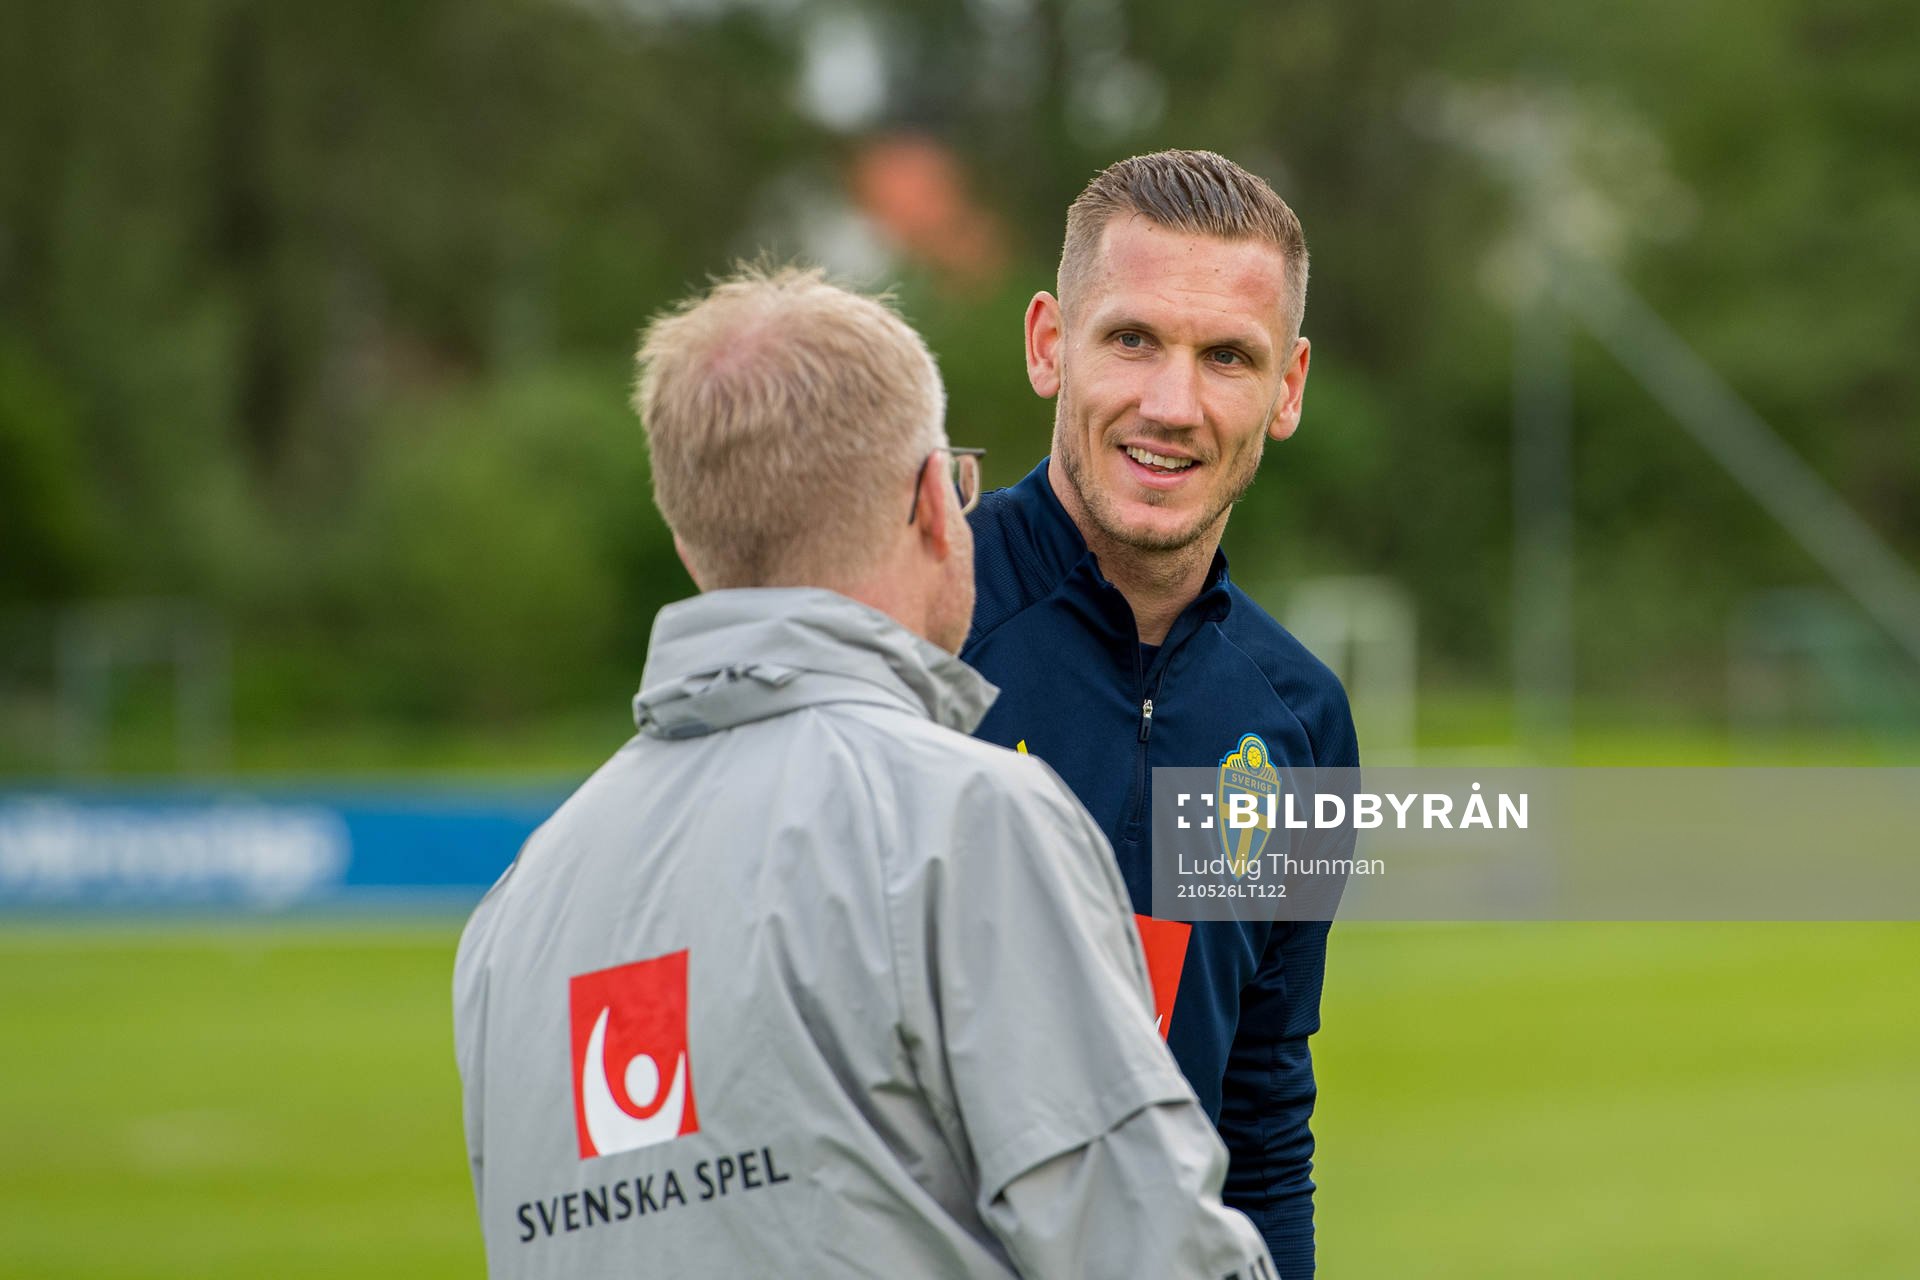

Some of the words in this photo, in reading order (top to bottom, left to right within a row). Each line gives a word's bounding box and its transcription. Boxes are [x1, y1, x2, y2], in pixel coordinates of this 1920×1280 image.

[1231, 773, 1273, 794] SVERIGE
[516, 1169, 687, 1244] SVENSKA
[694, 1146, 791, 1202] SPEL
